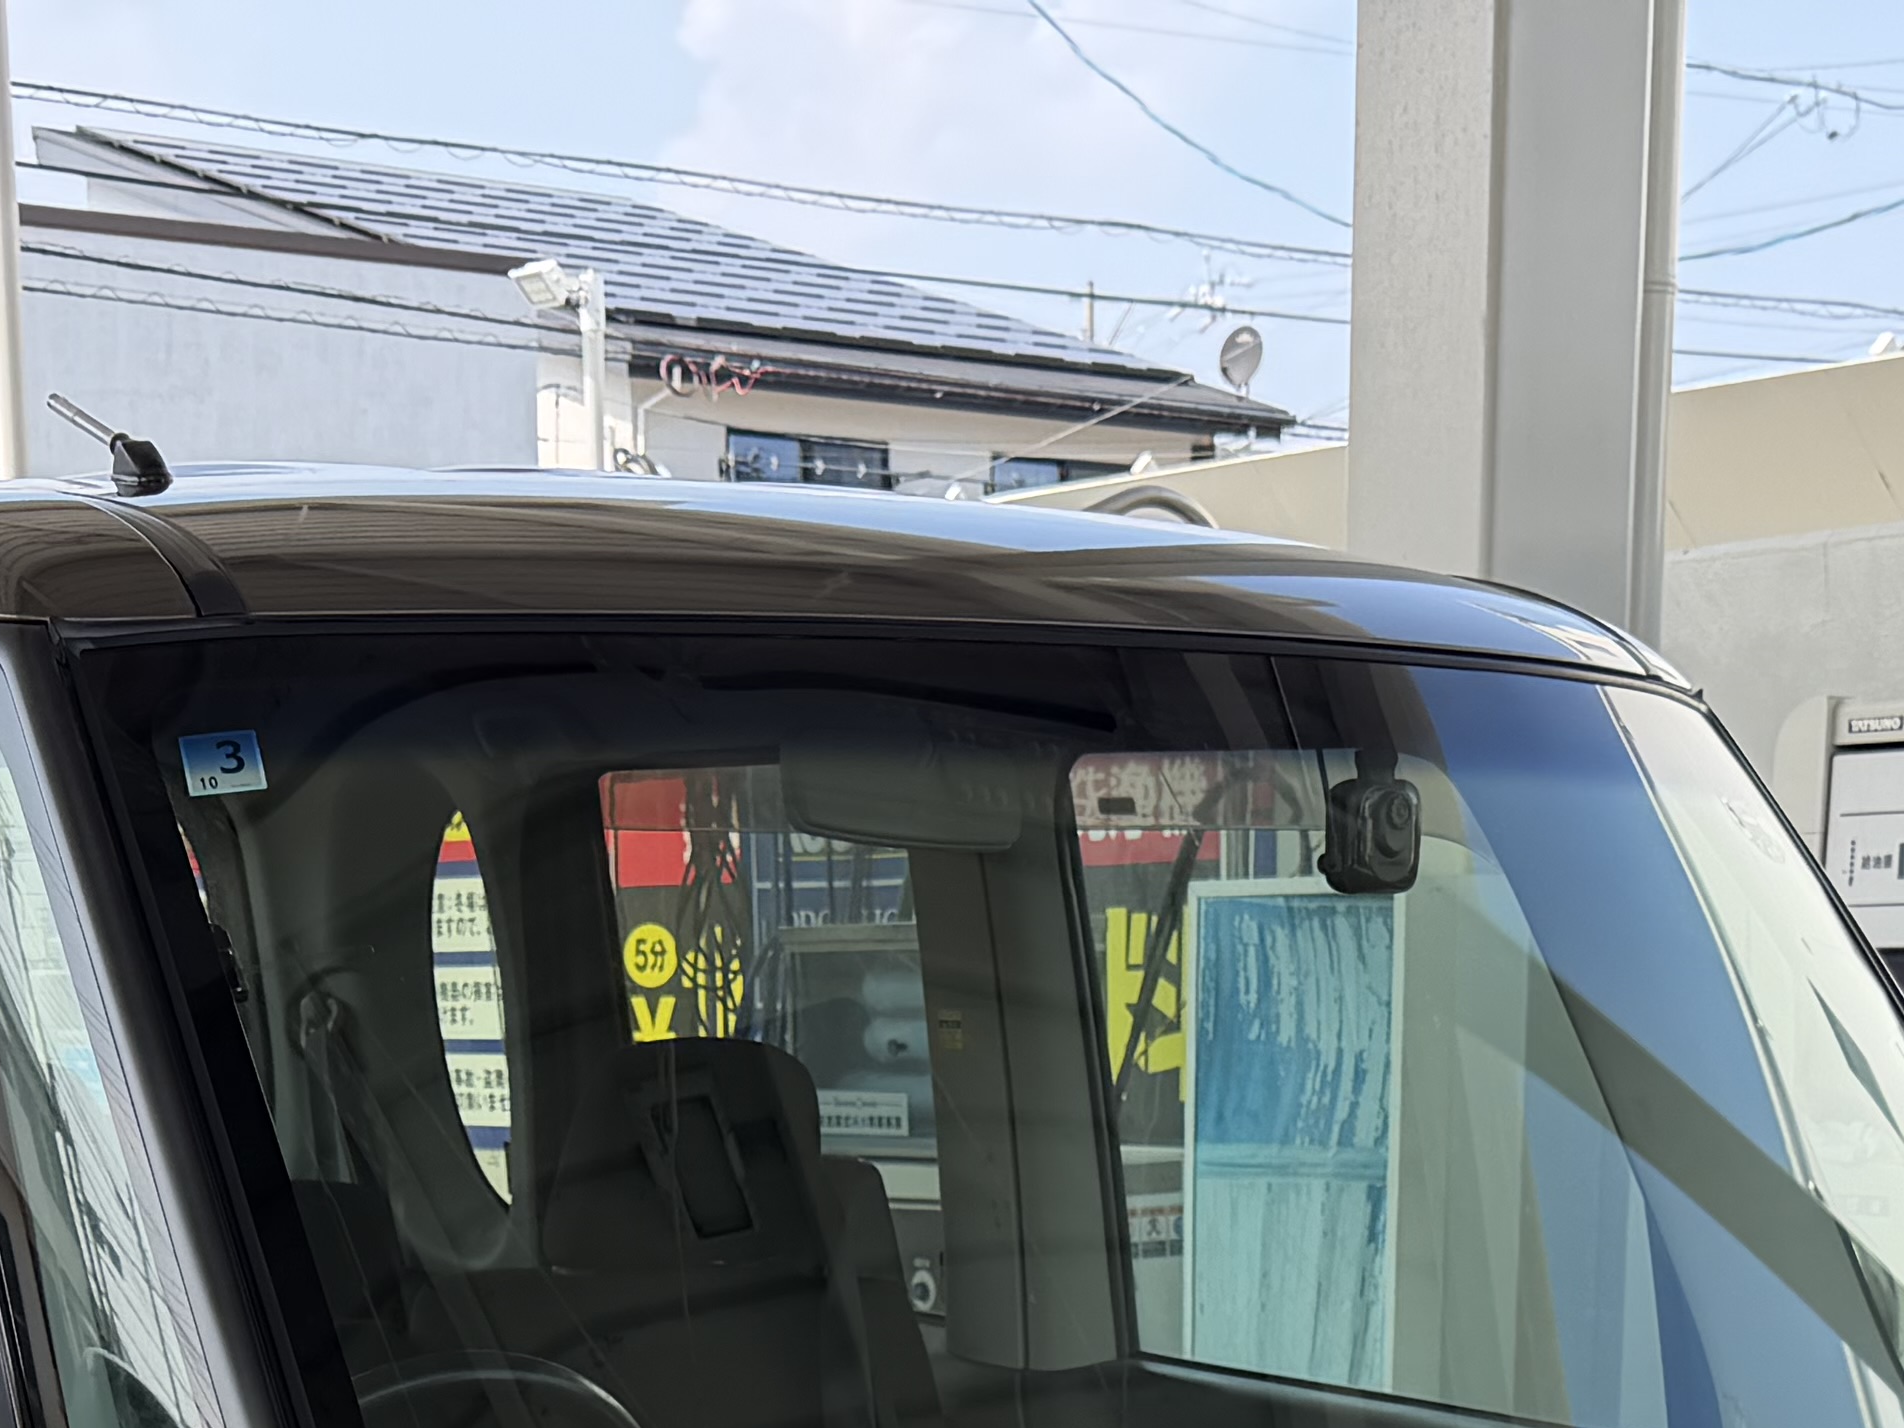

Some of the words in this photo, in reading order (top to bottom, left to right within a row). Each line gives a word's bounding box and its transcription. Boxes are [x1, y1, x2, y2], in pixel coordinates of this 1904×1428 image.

[216, 740, 245, 774] 3
[200, 776, 218, 790] 10
[634, 938, 667, 973] 5分
